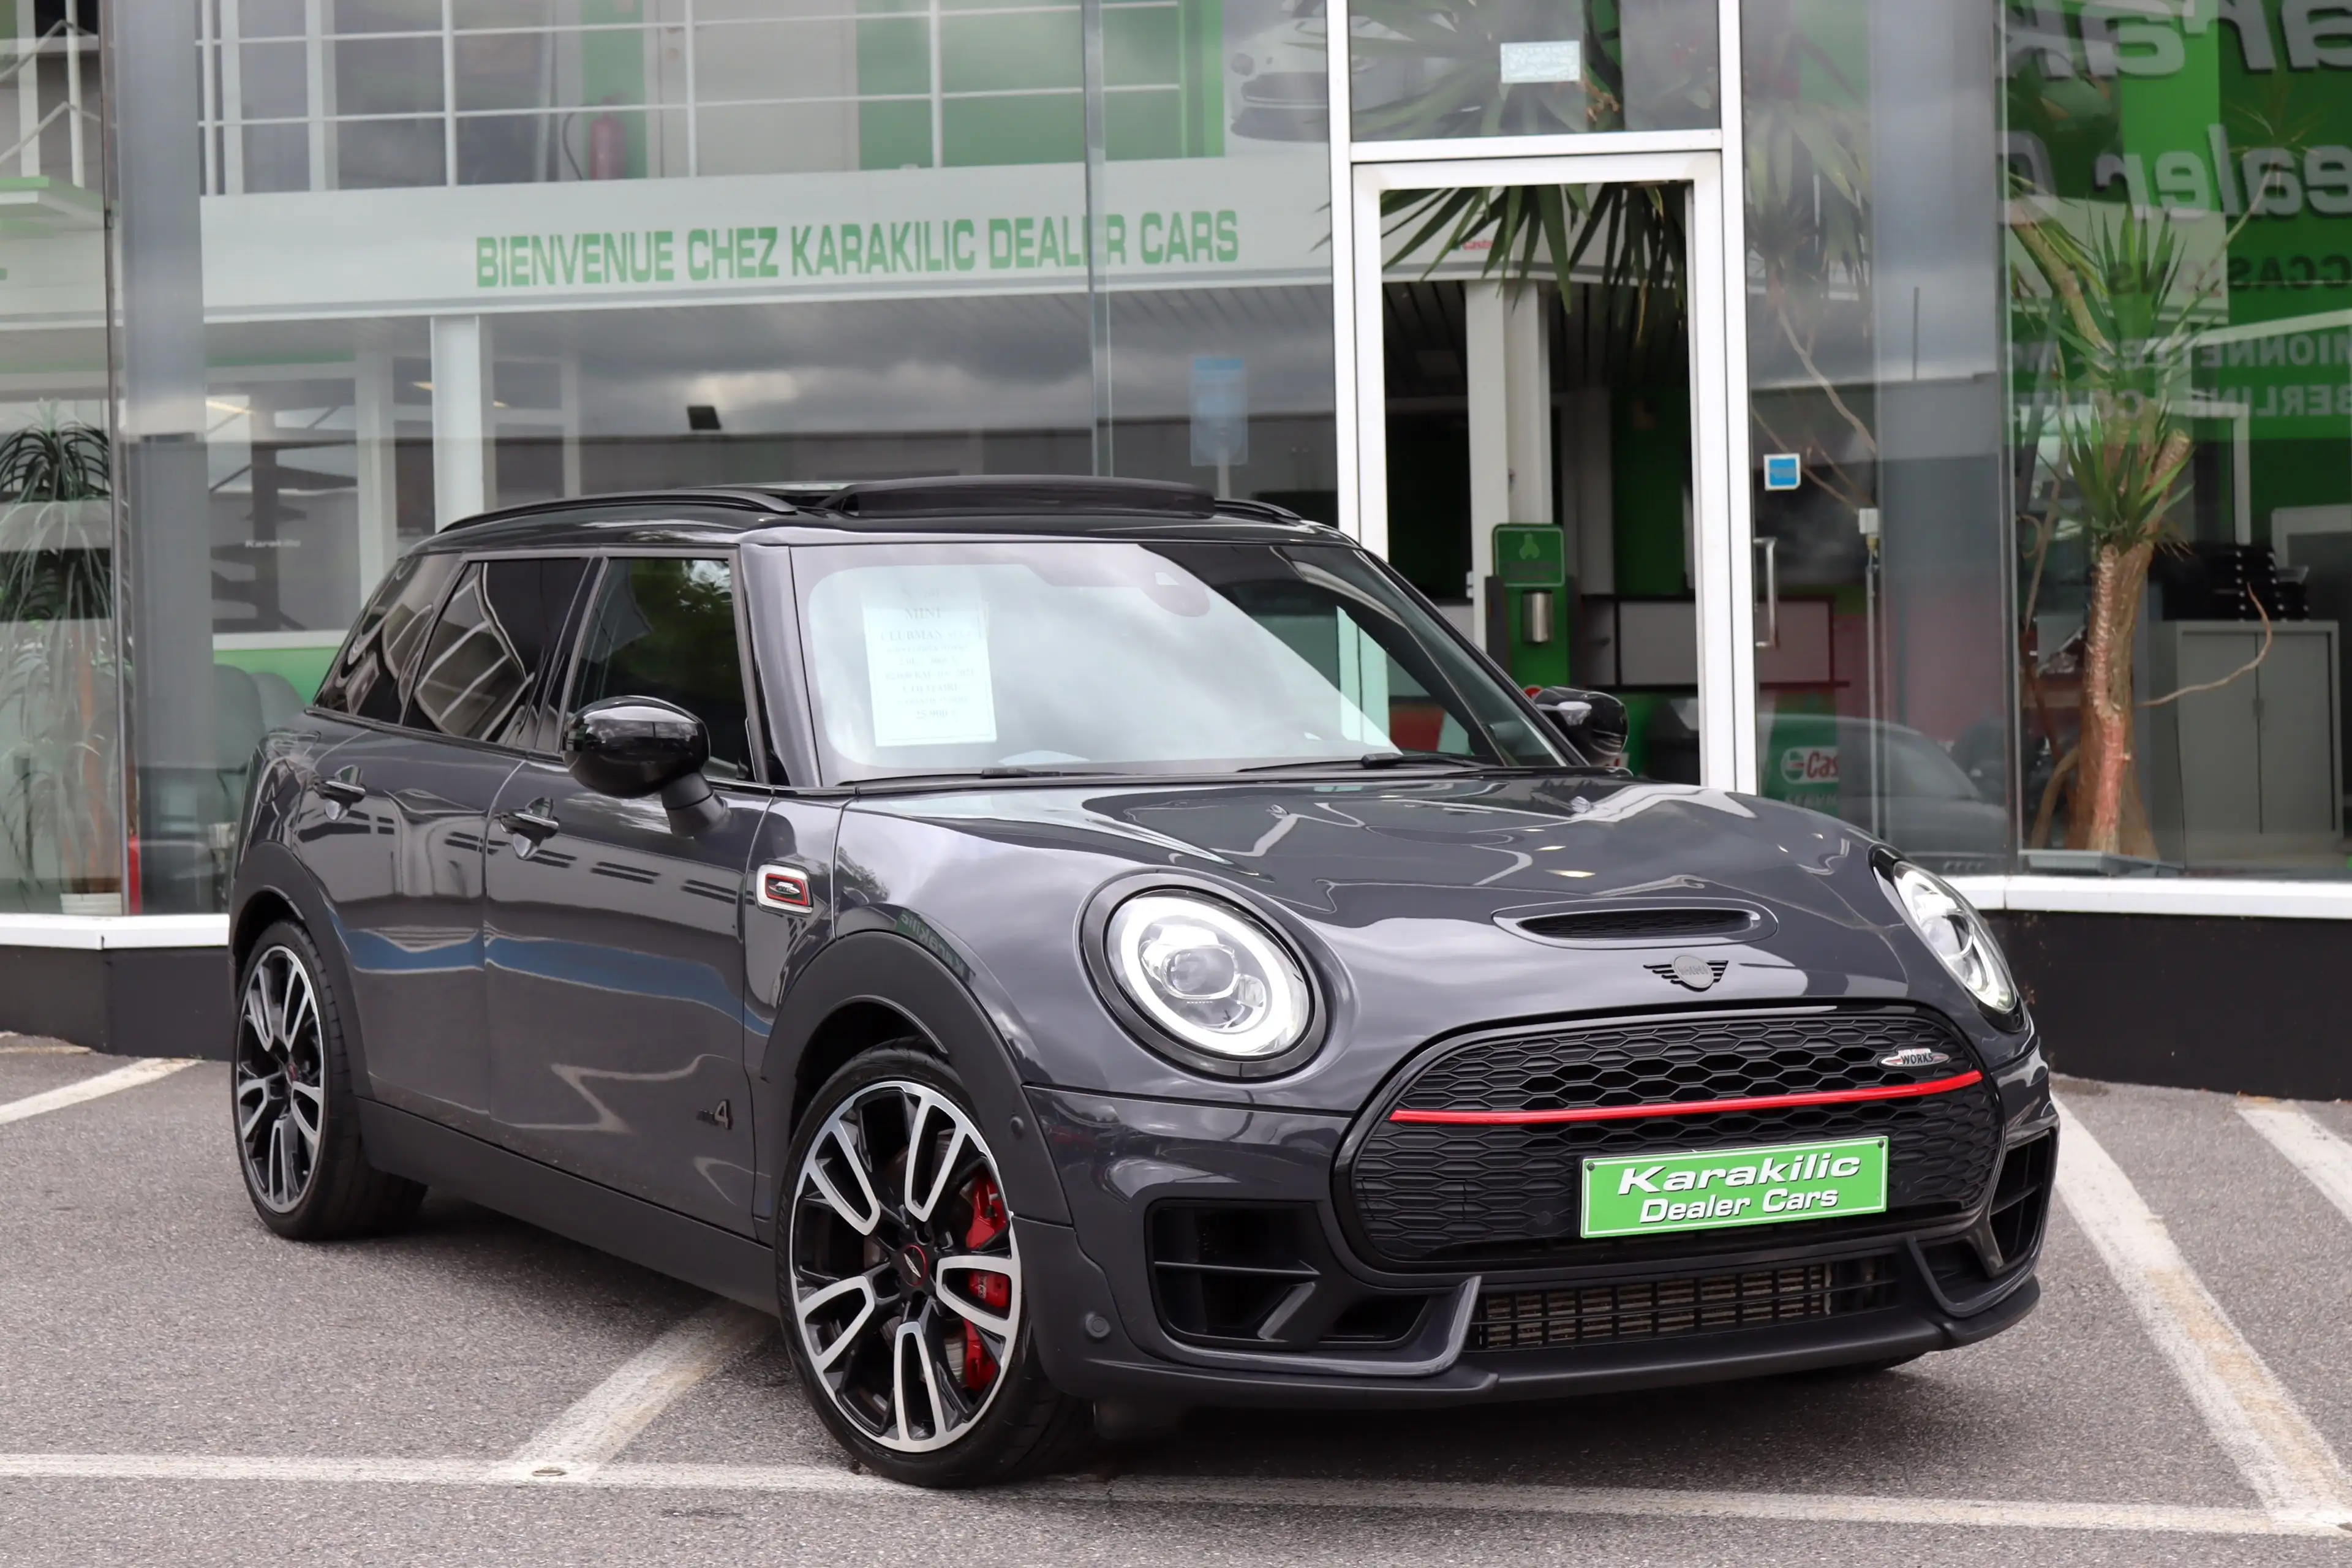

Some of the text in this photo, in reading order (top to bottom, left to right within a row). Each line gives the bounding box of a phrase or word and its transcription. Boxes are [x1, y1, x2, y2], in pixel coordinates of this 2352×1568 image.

[476, 209, 1239, 287] BIENVENUE CHEZ KARAKILIC DEALER CARS
[1901, 1052, 1934, 1065] WORKS
[1617, 1152, 1861, 1196] Karakilic
[1639, 1187, 1839, 1224] Dealer Cars
